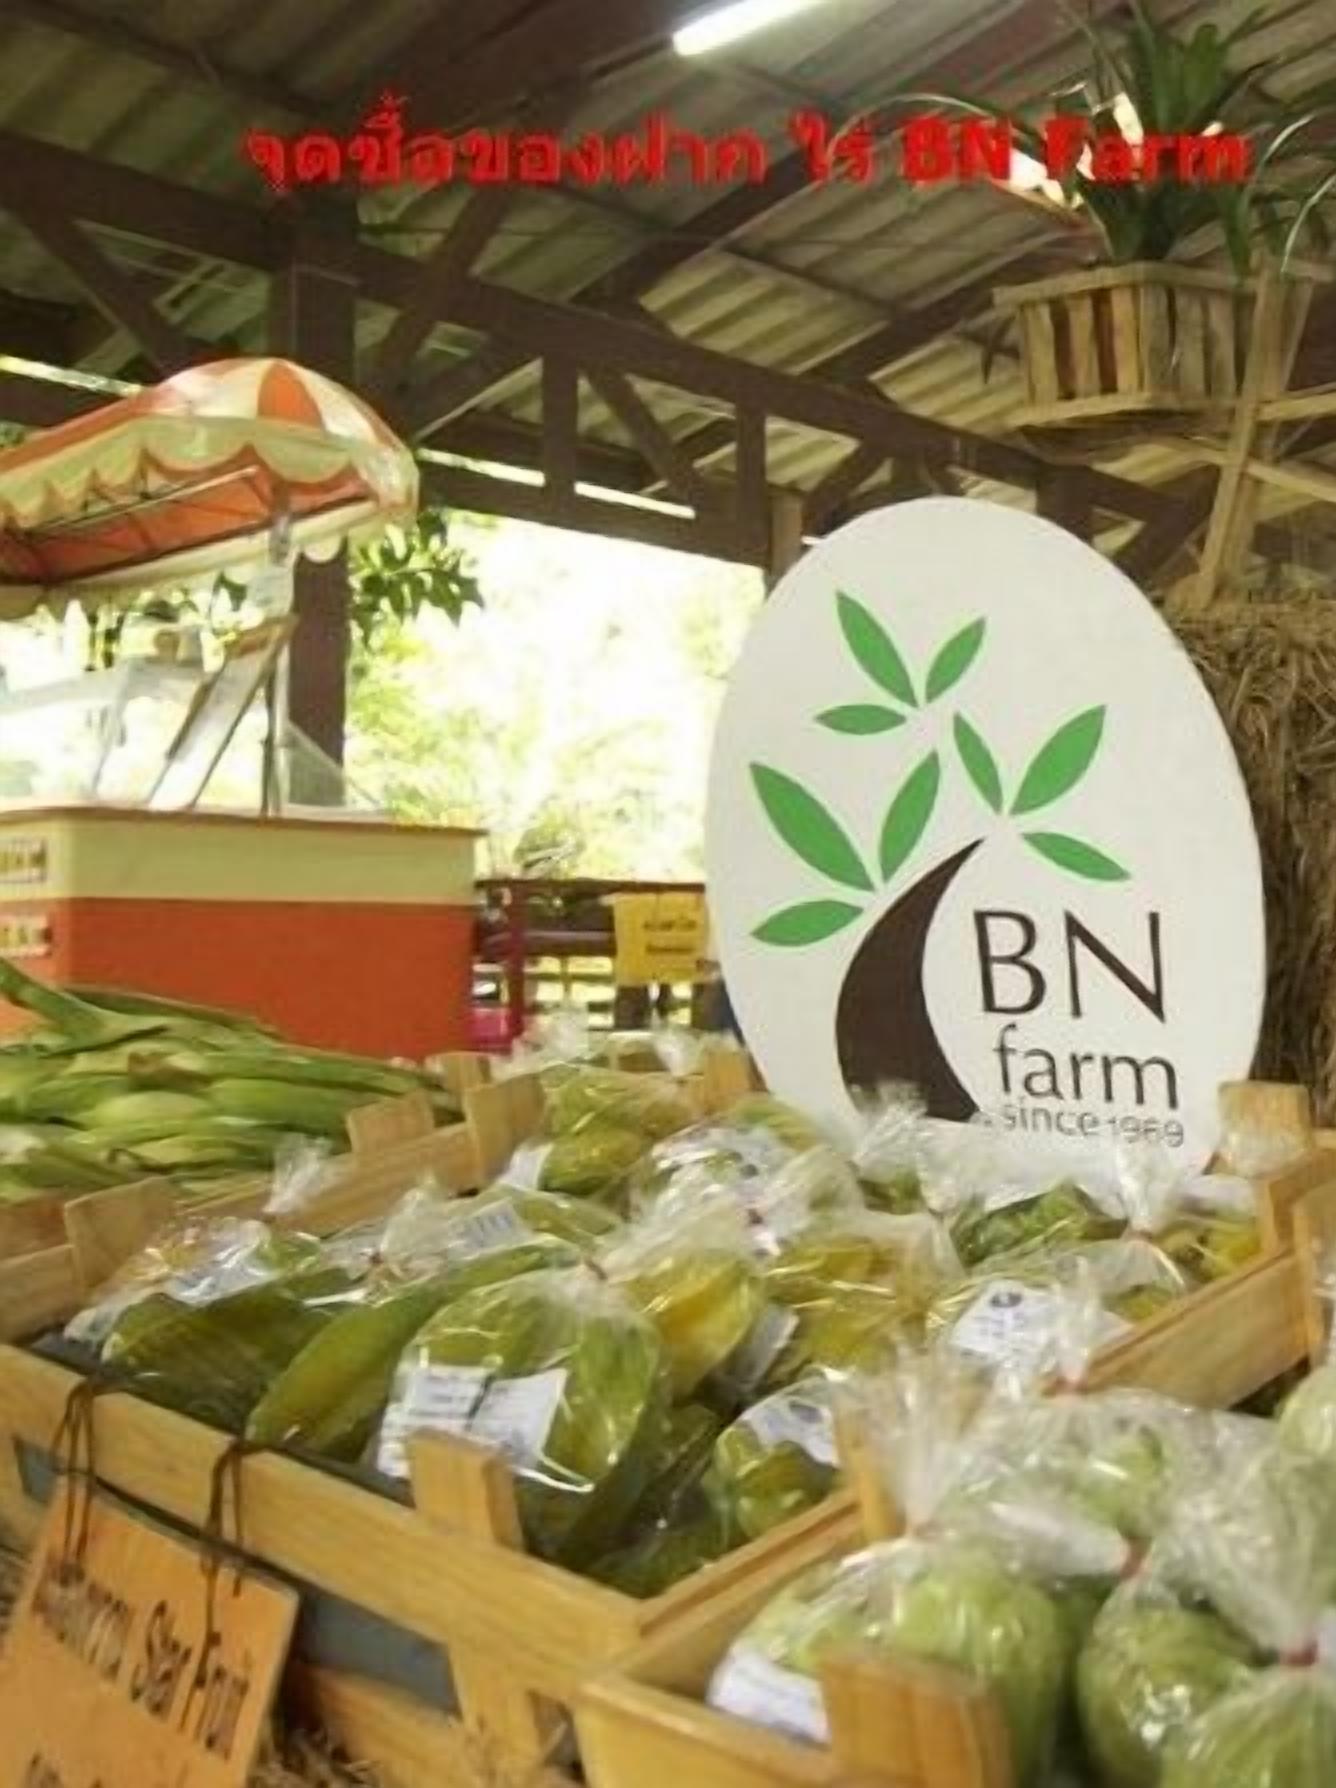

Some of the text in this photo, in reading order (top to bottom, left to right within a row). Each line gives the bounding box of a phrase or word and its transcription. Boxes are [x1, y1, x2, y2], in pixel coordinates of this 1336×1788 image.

[973, 909, 1166, 1023] BN
[993, 1023, 1179, 1110] farm
[1001, 1095, 1100, 1137] since
